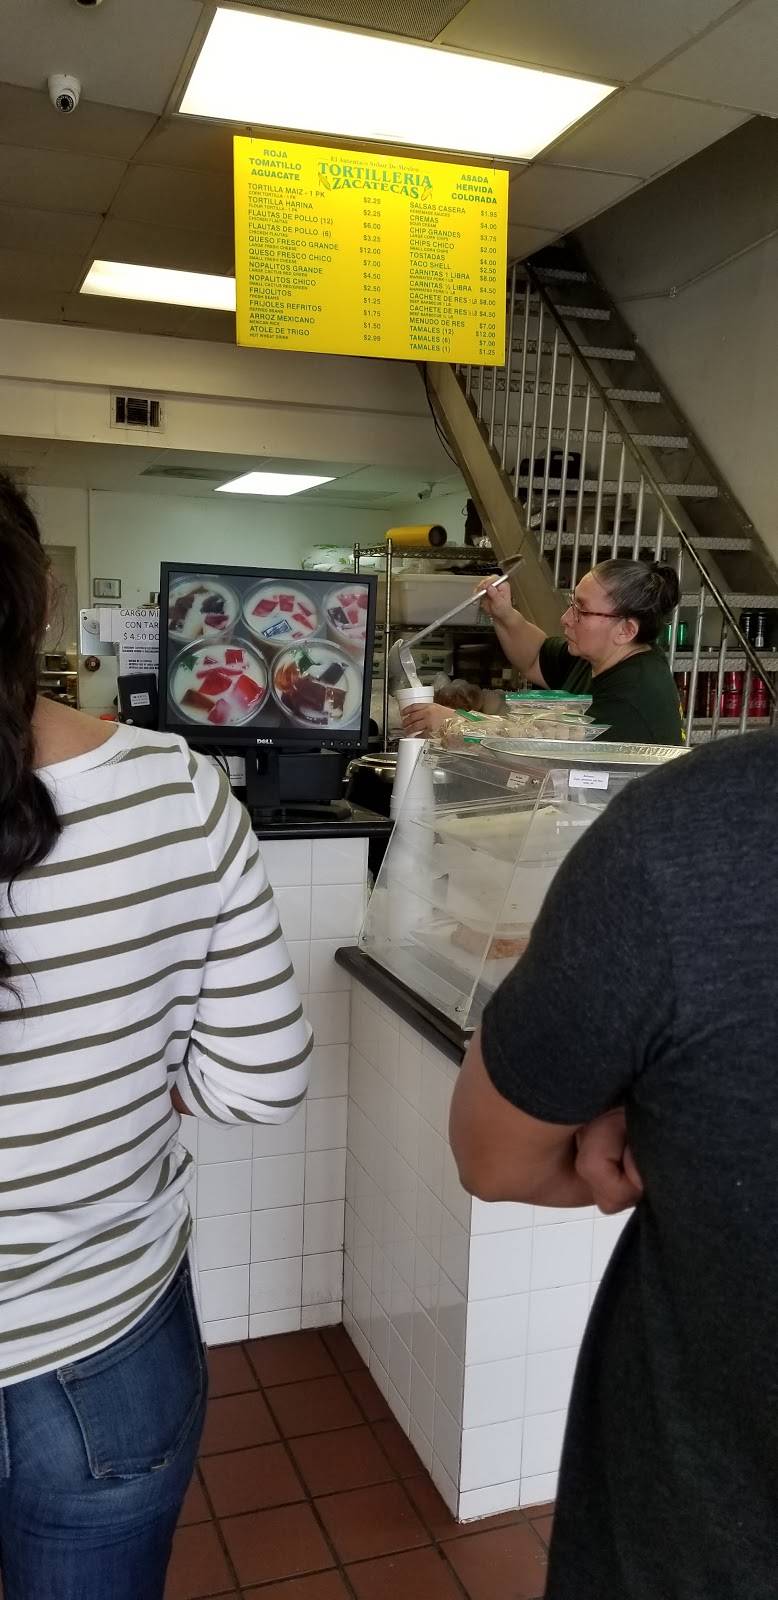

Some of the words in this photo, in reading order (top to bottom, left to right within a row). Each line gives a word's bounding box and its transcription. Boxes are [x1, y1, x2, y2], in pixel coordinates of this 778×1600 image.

[263, 149, 287, 158] ROJA
[250, 158, 301, 170] TOMATILLO
[251, 169, 300, 180] AGUACATE
[319, 162, 432, 188] TORTILLERIA
[461, 174, 488, 183] ASADA
[248, 183, 283, 192] TORTILLA
[286, 187, 303, 195] MAIZ
[333, 178, 419, 198] ZACATECAS
[457, 184, 493, 193] HERVIDA
[248, 196, 283, 206] TORTILLA
[286, 201, 313, 209] HARINA
[452, 193, 496, 203] COLORADA
[410, 202, 436, 210] SALSAS
[249, 210, 280, 219] FLAUTAS
[295, 215, 318, 223] POLLO
[410, 215, 438, 223] CREMAS
[249, 223, 280, 231] FLAUTAS
[429, 229, 461, 238] GRANDES
[277, 239, 306, 247] FRESCO
[309, 242, 339, 250] GRANDE
[359, 247, 380, 255] $12.00
[410, 252, 445, 261] TOSTADAS
[249, 262, 290, 270] NOPALITOS
[293, 266, 323, 274] GRANDE
[410, 269, 443, 277] CARNITAS
[249, 275, 290, 283] NOPALITOS
[410, 281, 442, 289] CARNITAS
[250, 287, 291, 296] FRIJOLITOS
[410, 293, 441, 301] CACHETE
[250, 300, 284, 308] FRIJOLES
[287, 303, 322, 312] REFRITOS
[410, 305, 441, 313] CACHETE
[277, 315, 315, 323] MEXICANO
[410, 317, 439, 325] MENUDO
[410, 334, 440, 342] TAMALES
